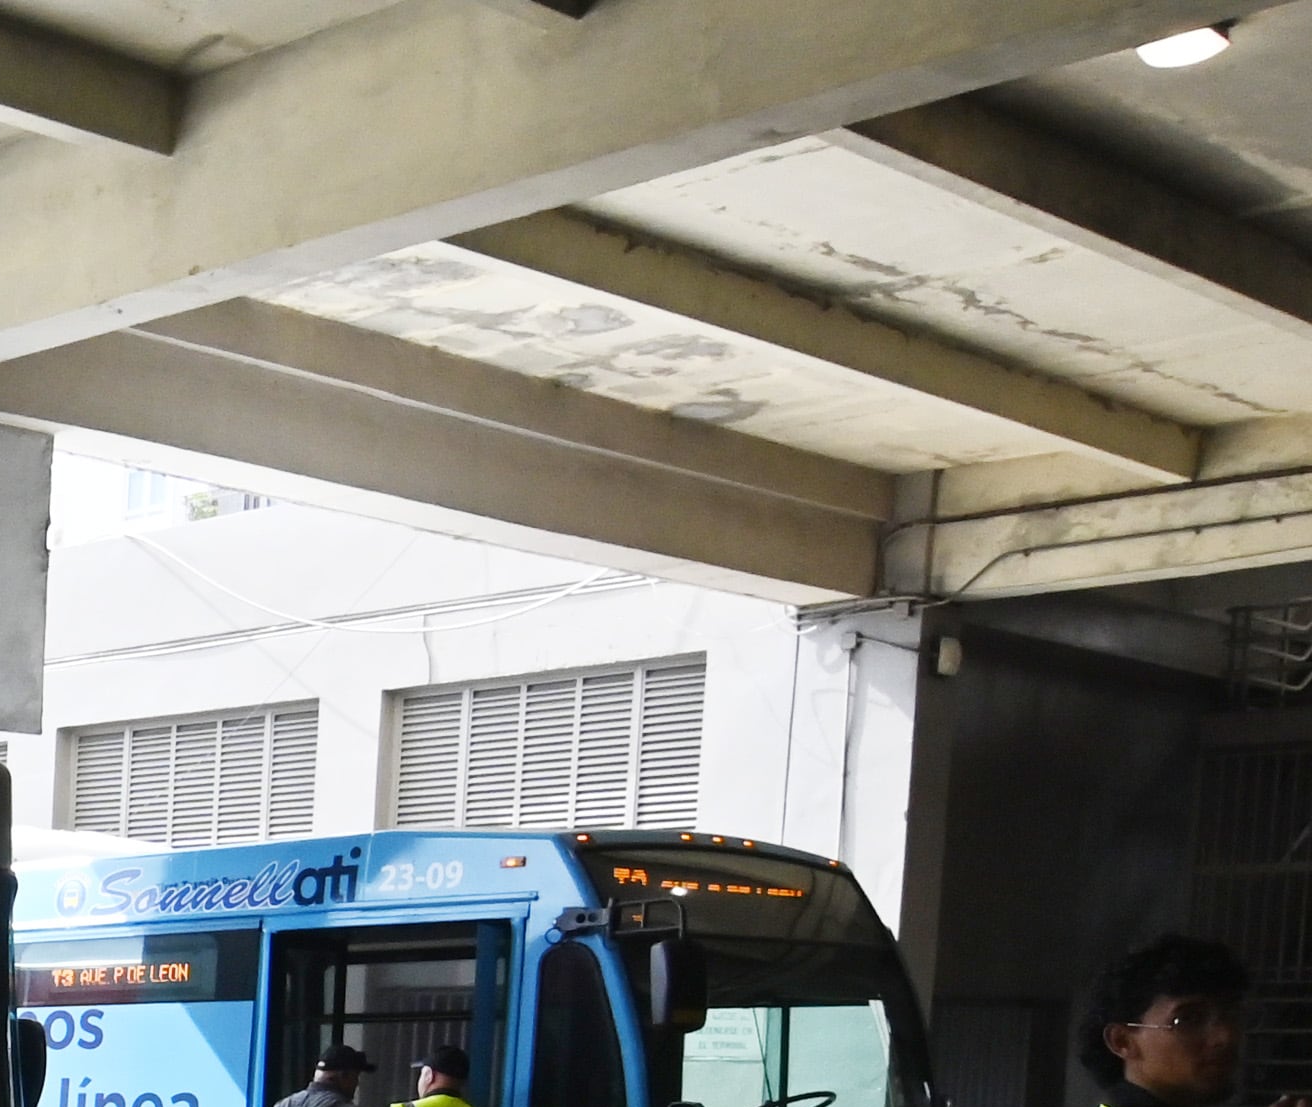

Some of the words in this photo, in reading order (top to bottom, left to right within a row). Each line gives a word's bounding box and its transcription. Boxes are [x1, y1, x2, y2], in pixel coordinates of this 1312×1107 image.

[89, 857, 301, 916] Sonnell
[291, 845, 363, 905] ati
[377, 859, 464, 894] 23-09
[114, 966, 126, 983] P
[150, 963, 190, 983] LEON
